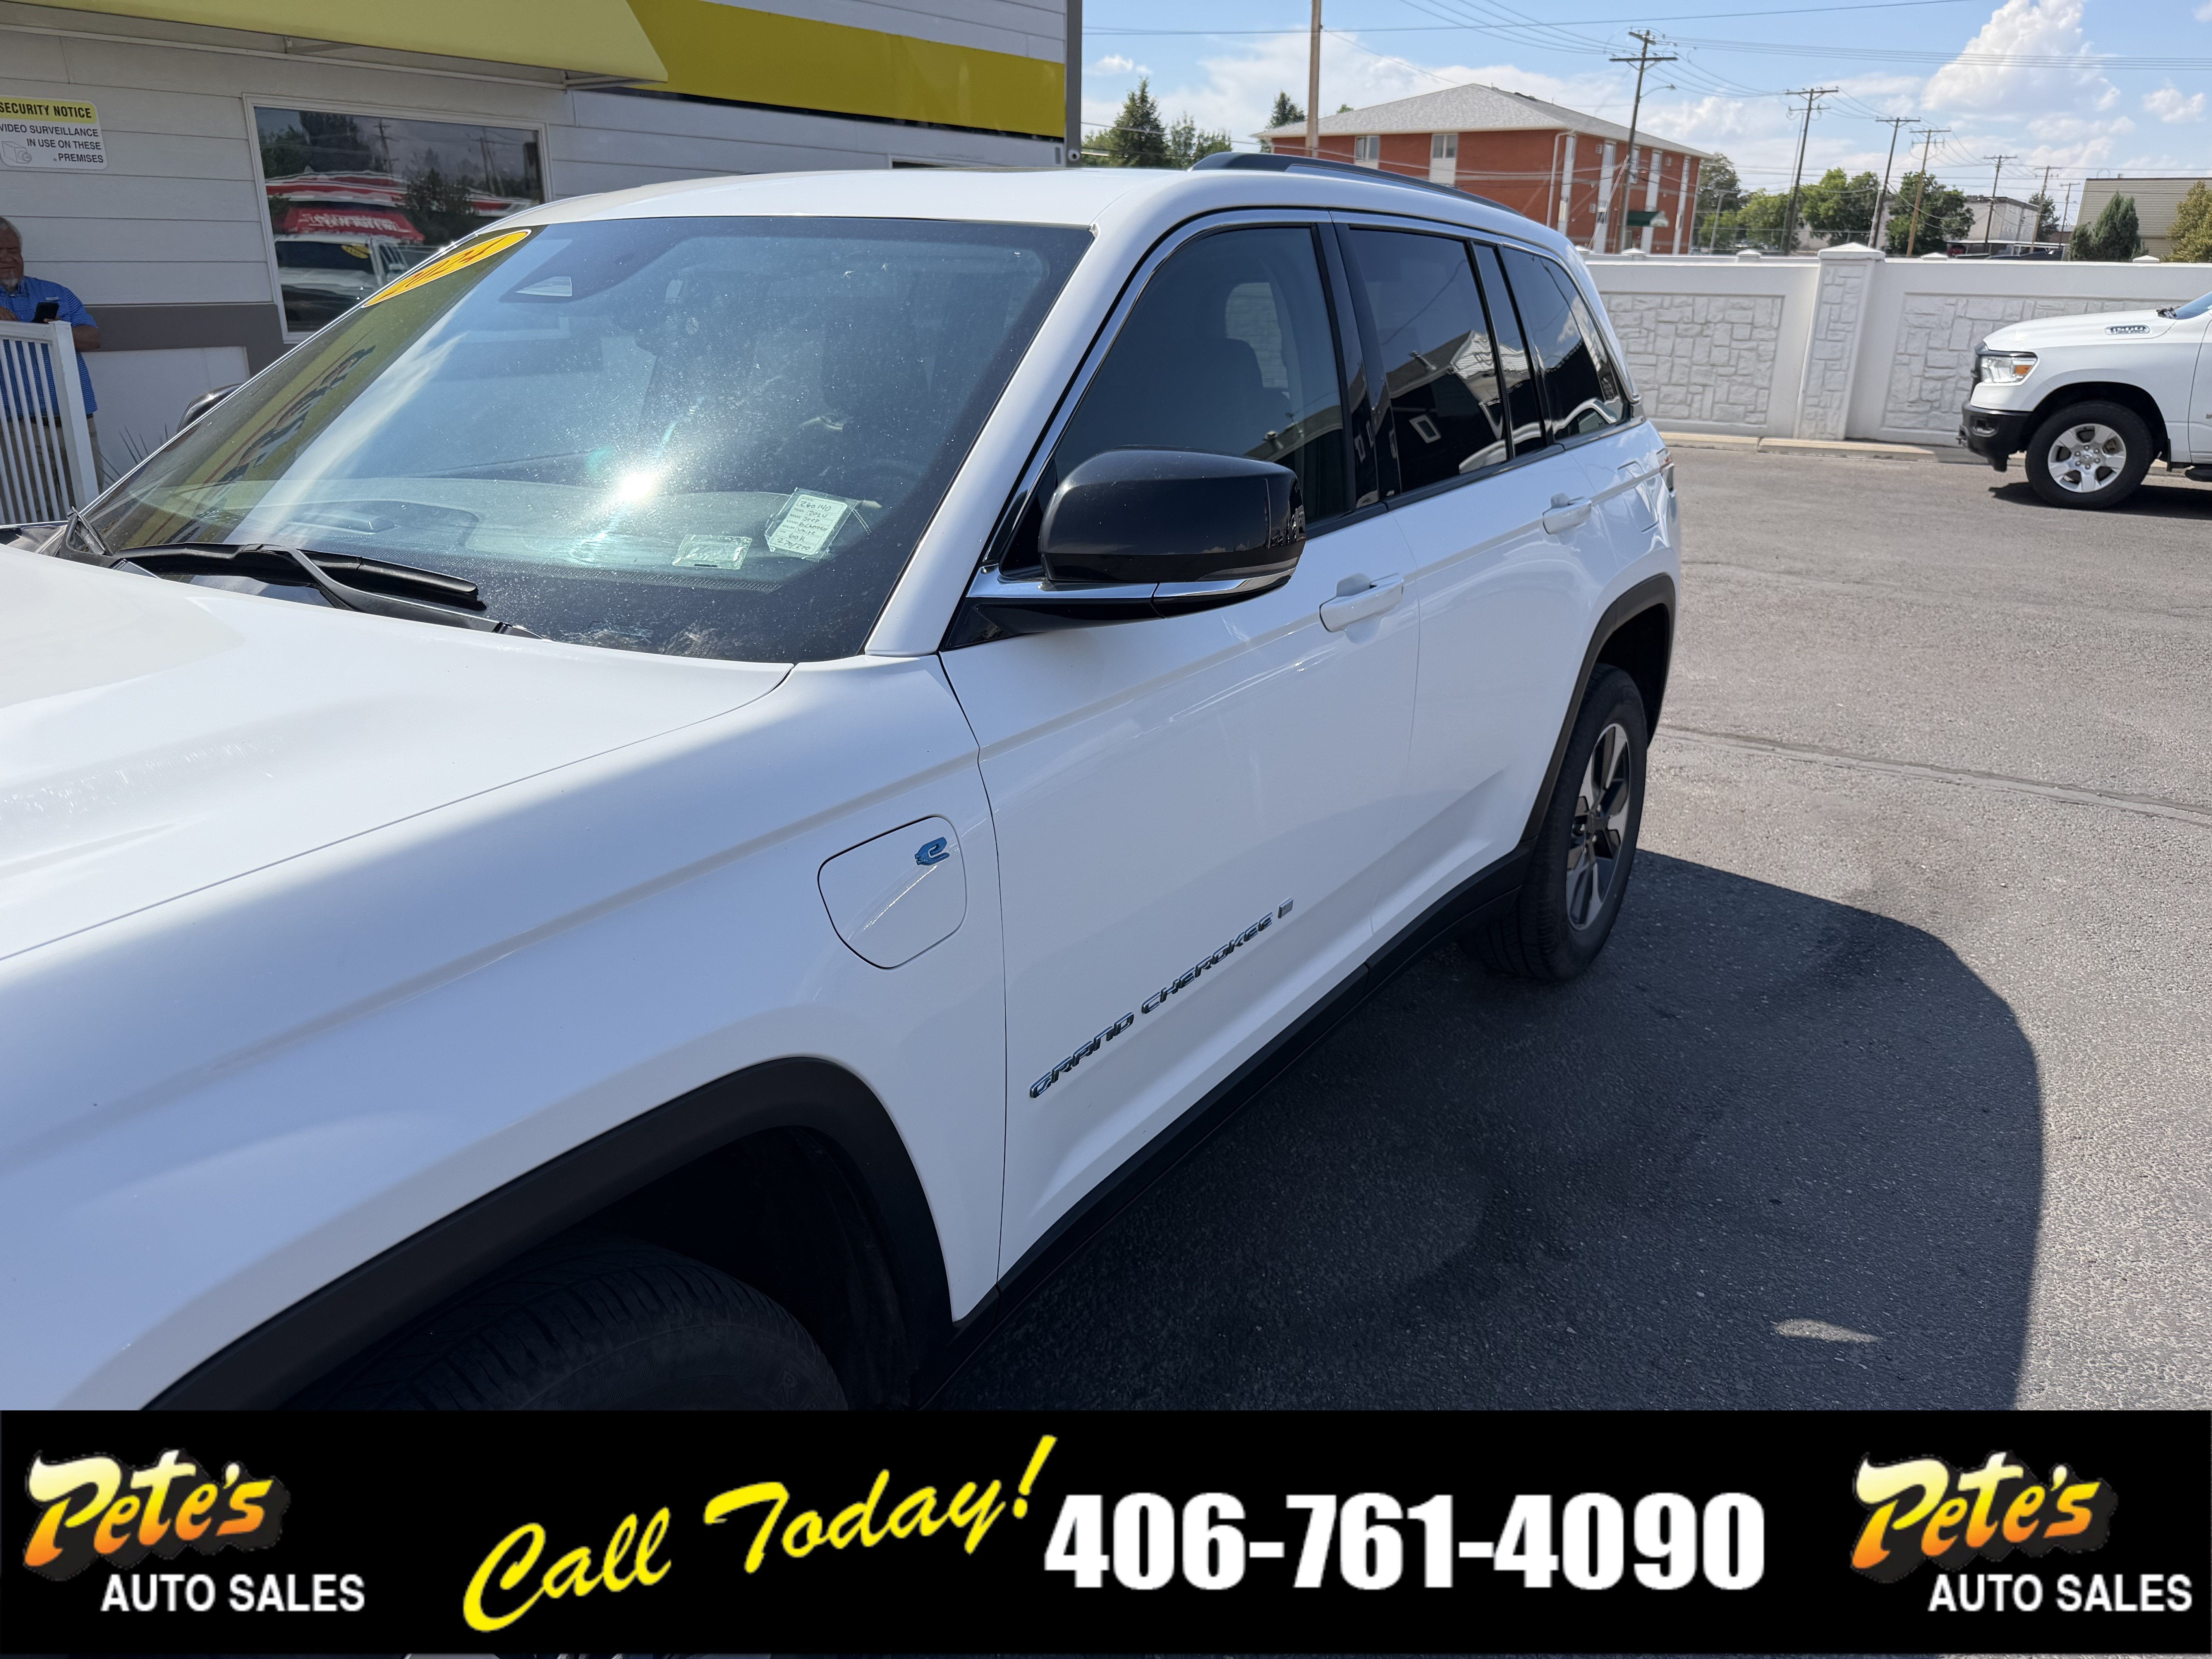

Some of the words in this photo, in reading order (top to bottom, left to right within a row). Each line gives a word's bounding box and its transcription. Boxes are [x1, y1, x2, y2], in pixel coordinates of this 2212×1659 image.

[0, 102, 49, 115] SECURITY
[53, 106, 91, 118] NOTICE
[29, 125, 99, 137] SURVEILLANCE
[27, 138, 36, 147] IN
[38, 139, 56, 148] USE
[72, 141, 101, 150] THESE
[58, 153, 103, 163] PREMISES
[809, 510, 828, 519] 2024
[1029, 1012, 1134, 1098] GRAND
[1141, 912, 1274, 1014] CHEROKEE
